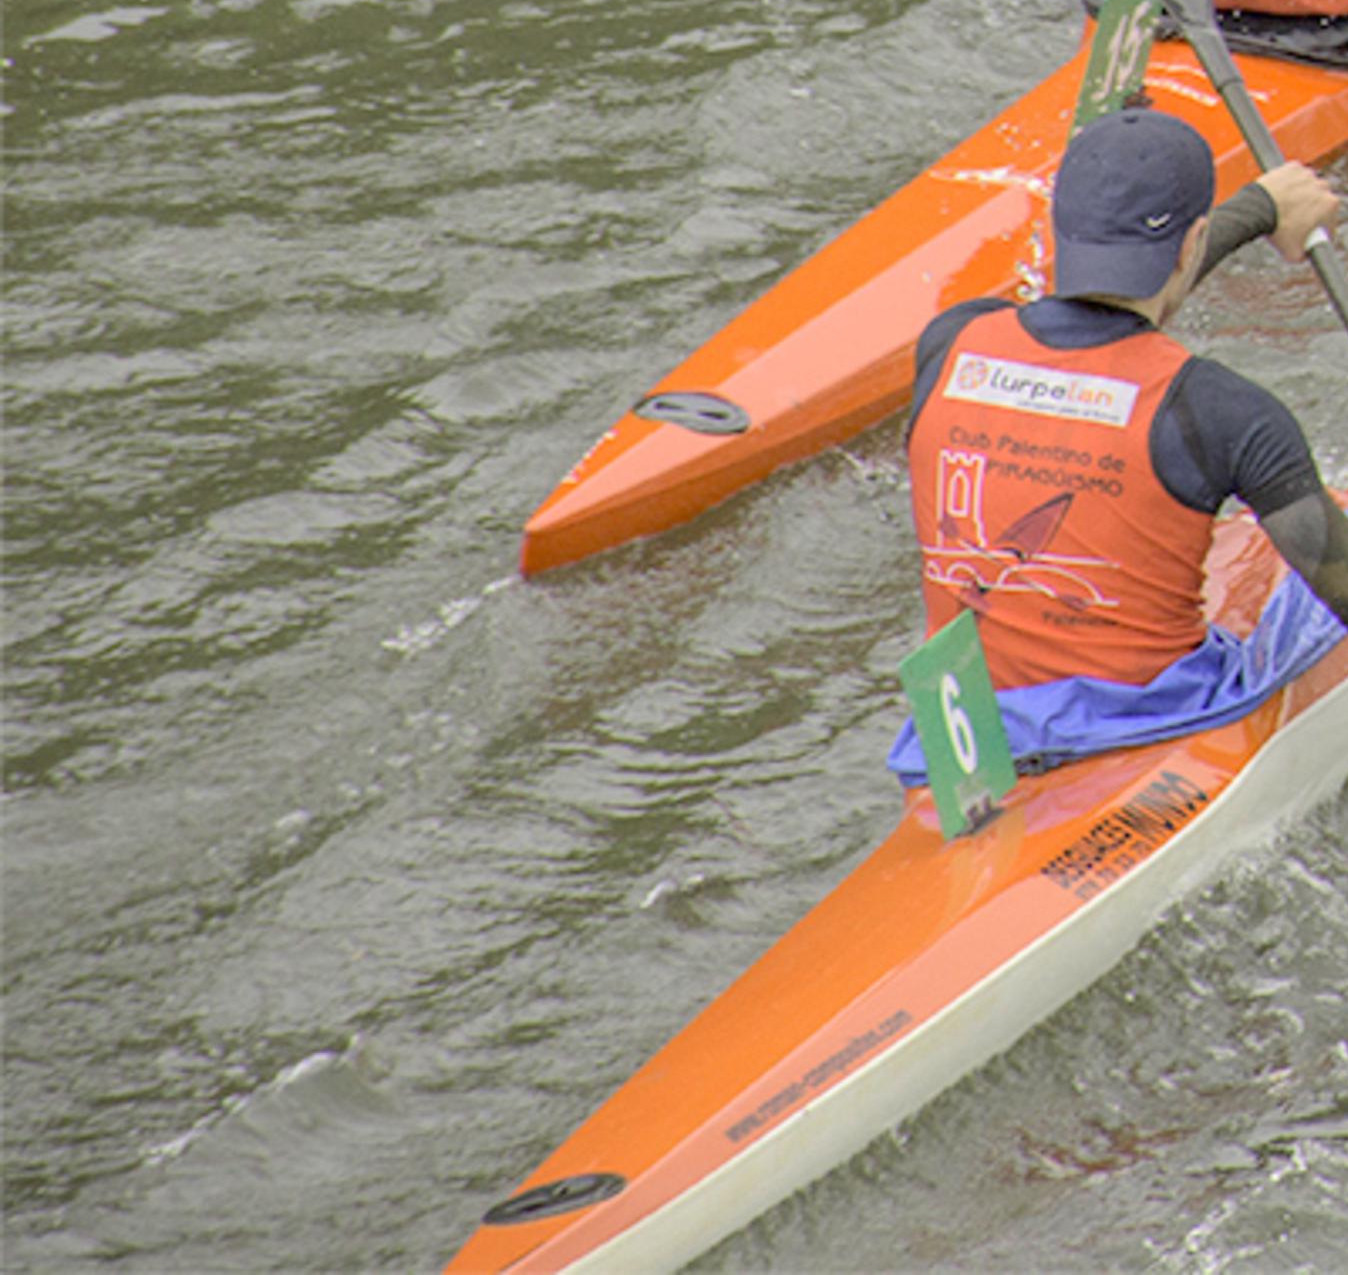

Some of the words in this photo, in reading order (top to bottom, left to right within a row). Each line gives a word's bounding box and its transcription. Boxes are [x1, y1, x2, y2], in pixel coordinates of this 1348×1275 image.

[948, 426, 991, 449] Club
[996, 433, 1093, 467] Palentino
[1097, 453, 1127, 473] de
[939, 673, 978, 775] 6
